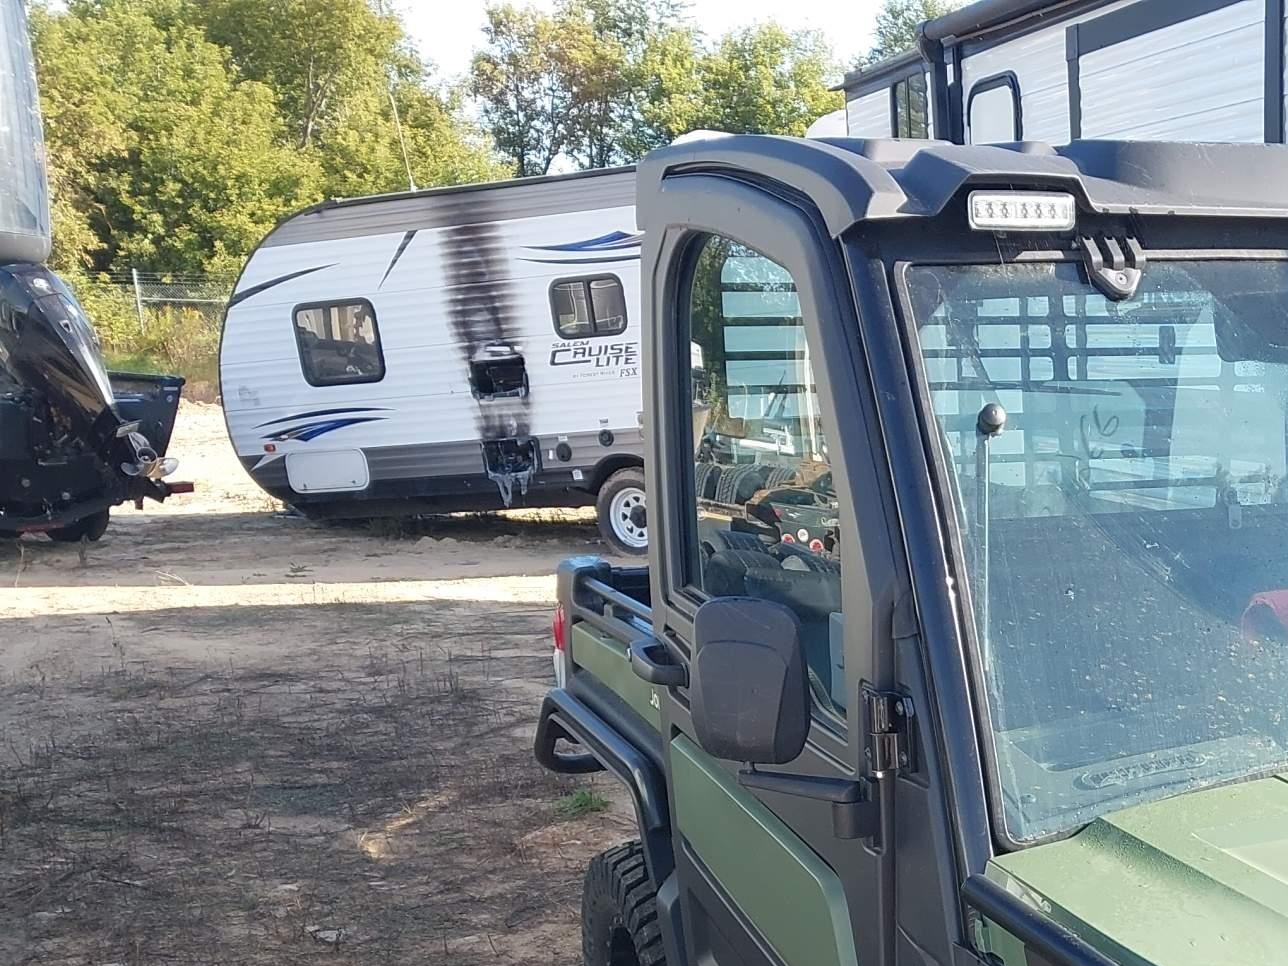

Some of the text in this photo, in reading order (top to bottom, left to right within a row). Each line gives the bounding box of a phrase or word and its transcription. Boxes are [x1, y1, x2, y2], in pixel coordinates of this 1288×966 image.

[551, 340, 590, 348] SALEM
[549, 342, 638, 366] CRUISE
[595, 354, 638, 367] LITE
[619, 367, 638, 377] FSX
[650, 687, 661, 710] Jo
